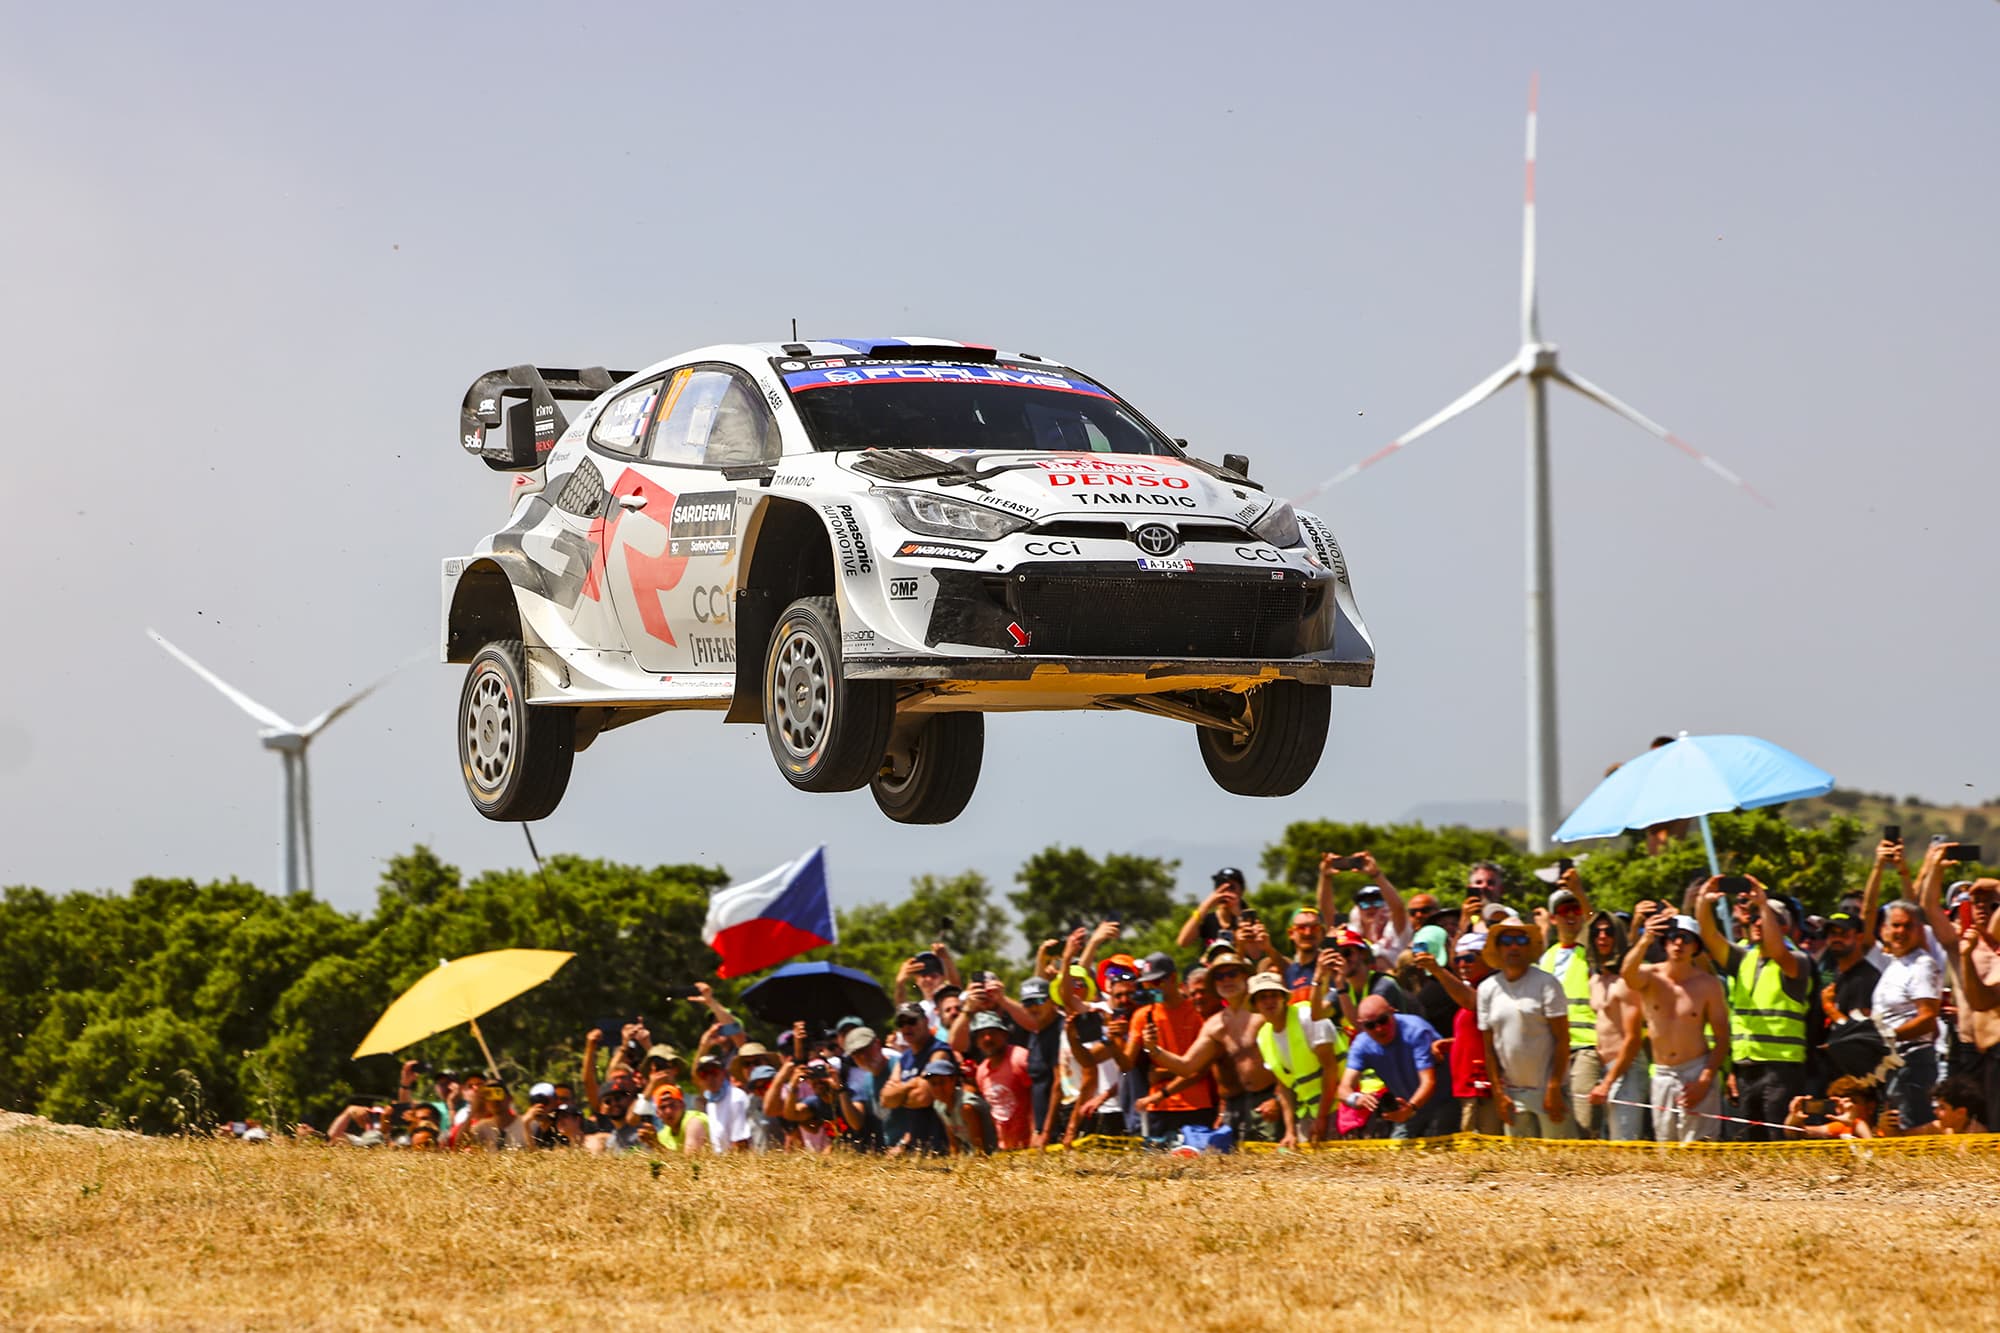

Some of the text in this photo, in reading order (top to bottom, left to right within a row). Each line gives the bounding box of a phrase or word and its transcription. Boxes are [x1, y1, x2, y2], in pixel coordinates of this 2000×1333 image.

[774, 475, 815, 487] TAMADIC
[1047, 473, 1189, 489] DENSO
[1072, 493, 1197, 508] TAMADIC
[673, 503, 731, 523] SARDEGNA
[690, 540, 730, 554] SafetyCulture
[821, 505, 858, 577] AUTOMOTIVE
[837, 505, 873, 574] Panasonic
[1297, 515, 1332, 570] anasonic
[1025, 541, 1081, 556] CCi
[1235, 547, 1287, 563] CCi
[890, 581, 918, 597] OMP
